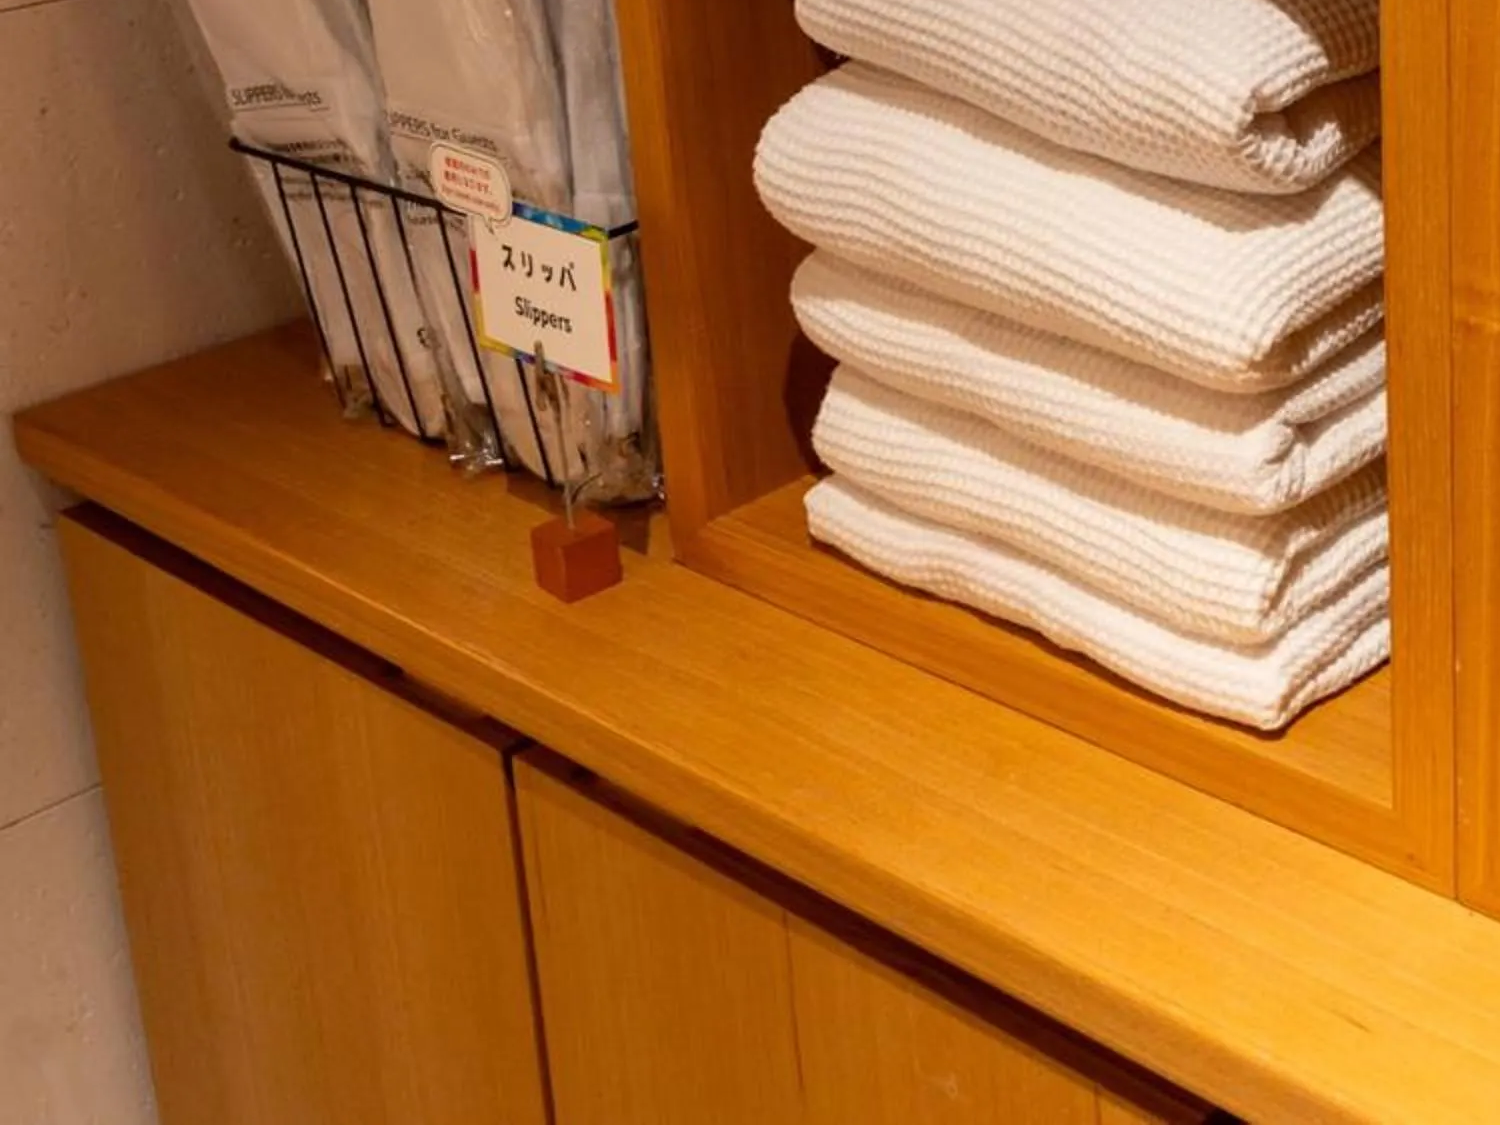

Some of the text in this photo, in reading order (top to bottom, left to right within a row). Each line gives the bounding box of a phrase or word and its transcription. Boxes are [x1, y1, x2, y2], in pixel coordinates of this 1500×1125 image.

[501, 243, 577, 292] スリッパ
[515, 295, 573, 334] Slippers
